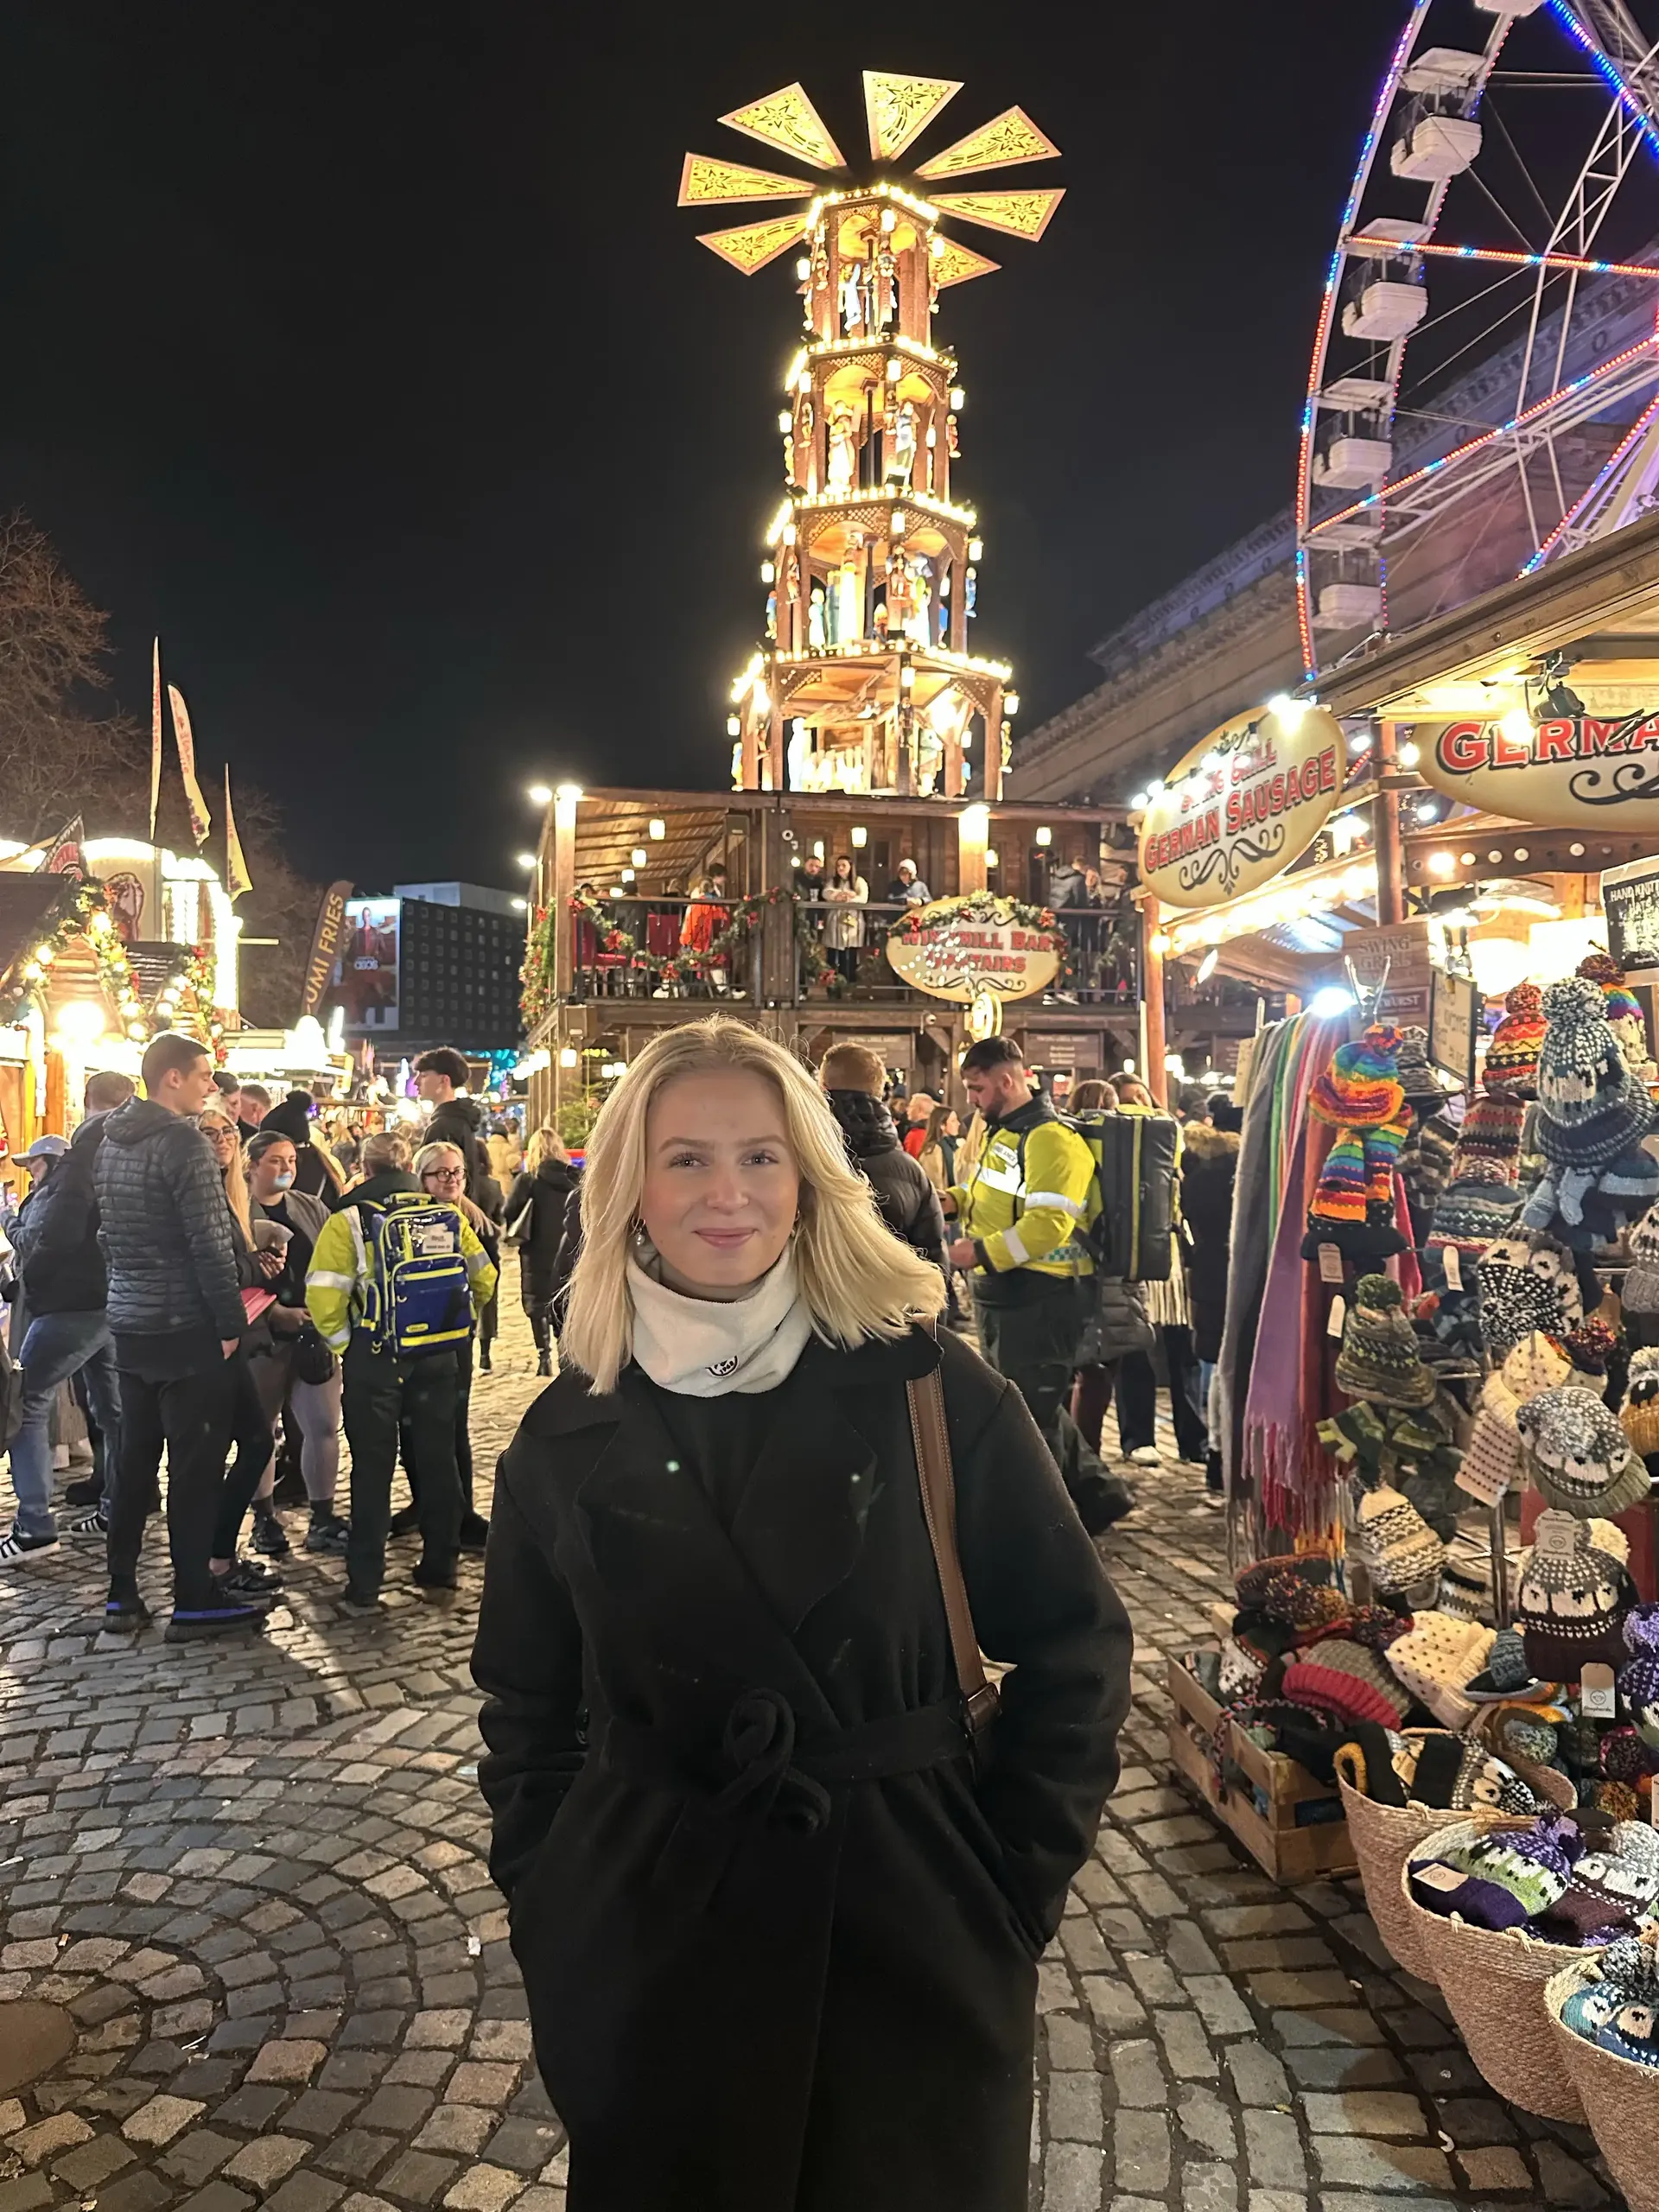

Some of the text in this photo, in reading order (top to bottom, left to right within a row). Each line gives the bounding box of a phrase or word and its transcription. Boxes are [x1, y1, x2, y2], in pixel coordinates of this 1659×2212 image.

[1145, 744, 1336, 874] GERMAN SAUSAGE
[1610, 886, 1632, 902] HAND
[307, 893, 343, 1013] UMI FRIES
[901, 929, 1052, 951] WINMILL BAR
